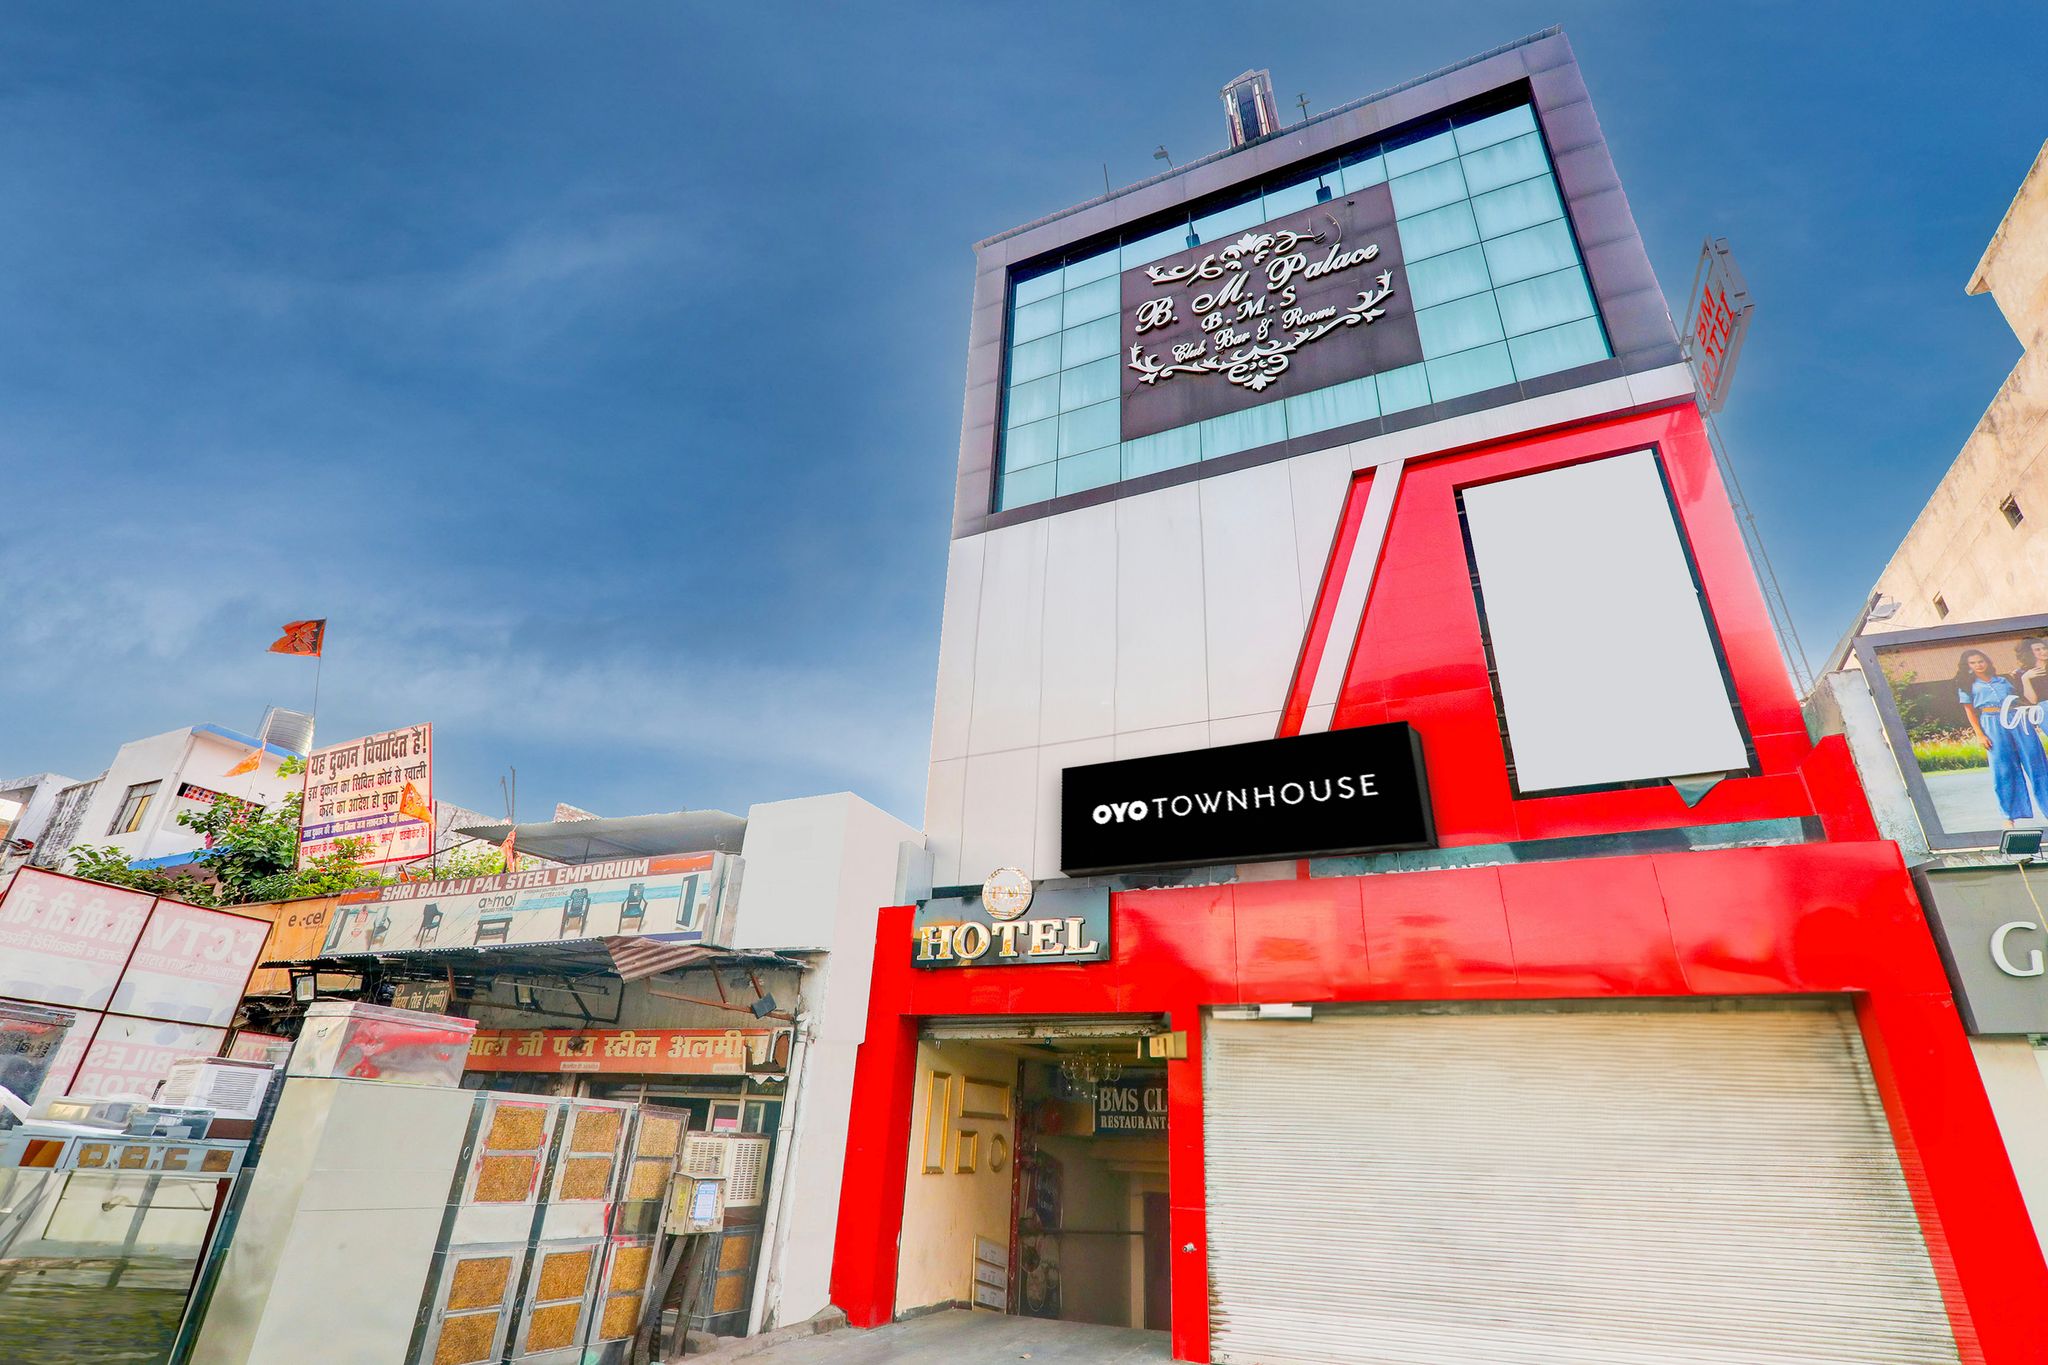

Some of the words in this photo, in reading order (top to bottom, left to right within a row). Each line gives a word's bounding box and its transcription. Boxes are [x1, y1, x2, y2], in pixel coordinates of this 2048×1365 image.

[1265, 243, 1379, 291] Palace
[1171, 339, 1207, 364] Club
[1214, 330, 1251, 352] Bar
[1257, 318, 1273, 343] &
[1282, 305, 1337, 331] Rooms
[311, 753, 327, 776] यह
[329, 745, 360, 780] दुकान
[363, 730, 408, 766] विवादित
[308, 785, 318, 801] इस
[320, 781, 338, 803] दुकान
[340, 779, 350, 794] का
[352, 772, 375, 792] सिविल
[377, 766, 393, 787] कोर्ट
[394, 765, 401, 783] से
[319, 800, 334, 818] करने
[336, 799, 346, 814] का
[348, 794, 370, 812] आदेश
[371, 790, 380, 809] हो
[382, 790, 398, 811] चुका
[1093, 800, 1148, 825] OYO
[1152, 774, 1379, 819] TOWNHOUSE
[381, 884, 416, 901] SHRI
[417, 878, 471, 897] BALAJI
[472, 876, 502, 893] PAL
[506, 870, 551, 890] STEEL
[555, 858, 650, 885] EMPORIUM
[916, 917, 1099, 961] HOTEL
[517, 1030, 547, 1057] जी
[604, 1030, 661, 1058] स्टील
[1099, 1087, 1139, 1112] BMS
[1143, 1087, 1168, 1113] CL
[1100, 1115, 1167, 1129] RESTAURANT
